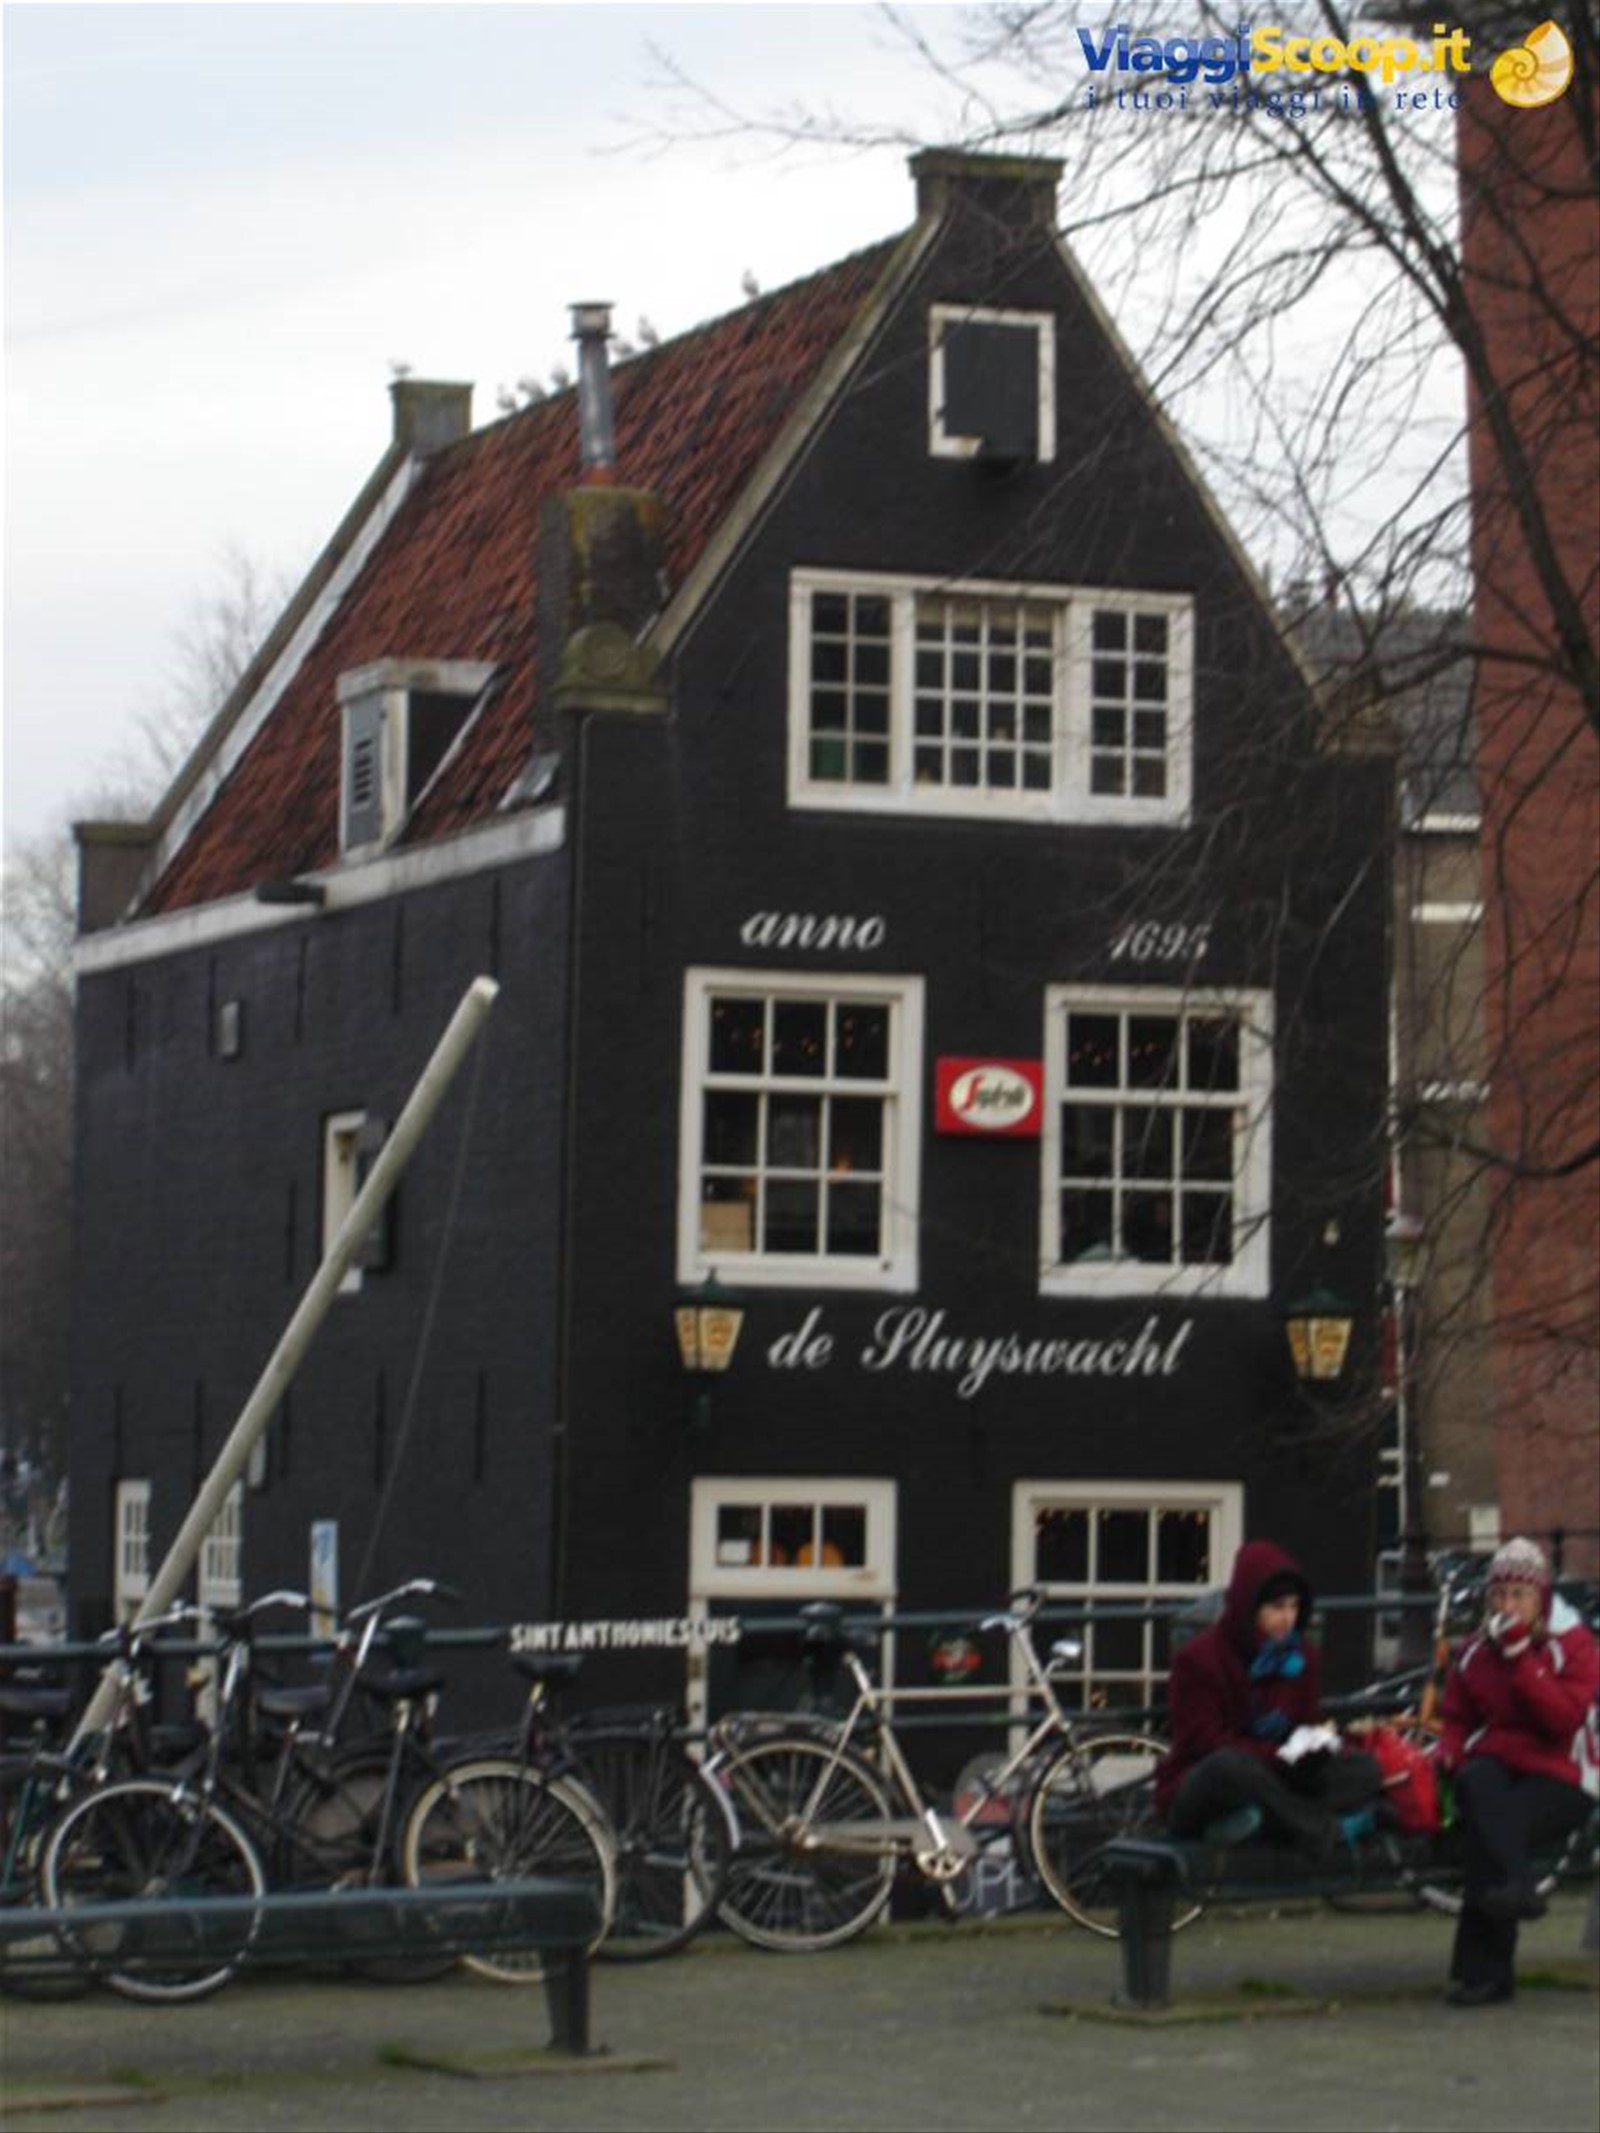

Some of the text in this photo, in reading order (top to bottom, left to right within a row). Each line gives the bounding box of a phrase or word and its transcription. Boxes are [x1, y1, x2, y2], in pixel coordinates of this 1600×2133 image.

[740, 910, 887, 951] anno
[1106, 919, 1211, 961] 1695
[767, 1306, 834, 1370] de
[510, 1622, 563, 1653] SINT
